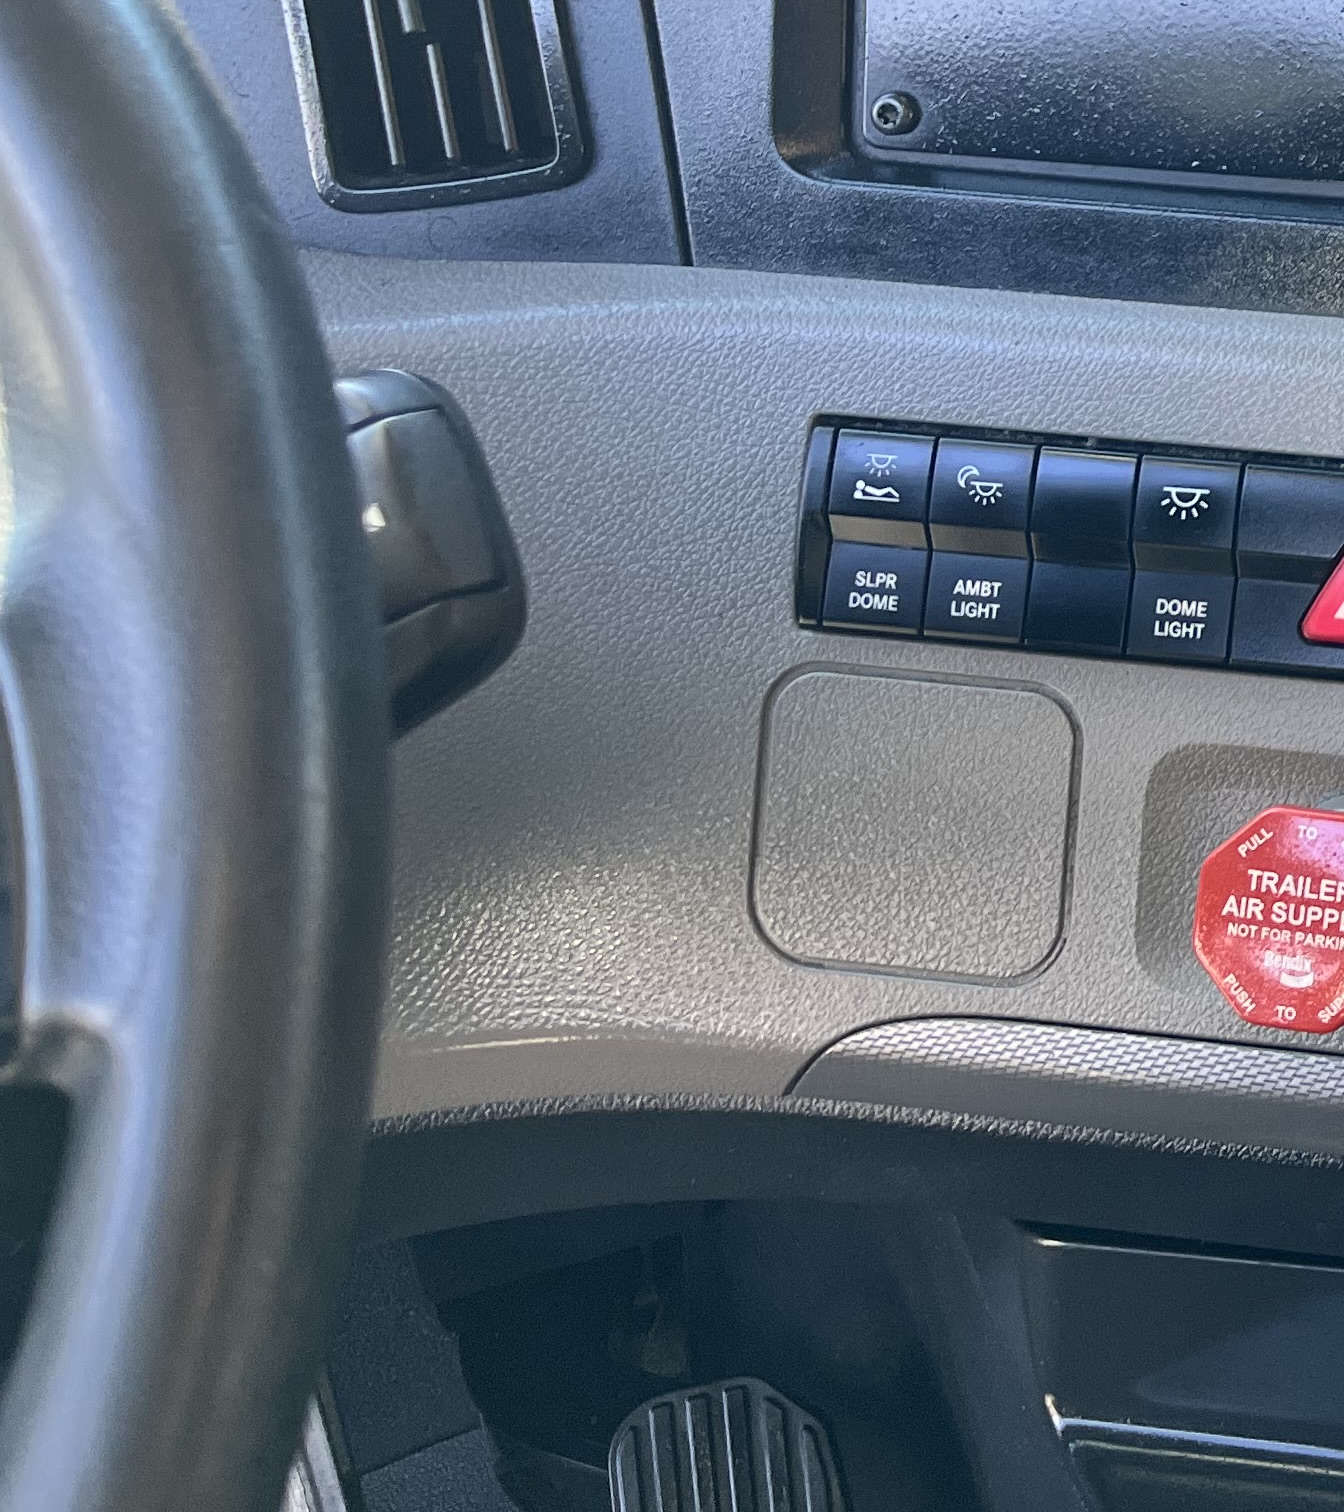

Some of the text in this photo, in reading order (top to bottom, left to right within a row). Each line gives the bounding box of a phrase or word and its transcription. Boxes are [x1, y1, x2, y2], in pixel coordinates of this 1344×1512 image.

[854, 571, 898, 590] SLPR
[952, 579, 1002, 599] AMBT
[848, 592, 898, 612] DOME
[950, 600, 1001, 620] LIGHT
[1155, 598, 1208, 619] DOME
[1153, 620, 1205, 640] LIGHT
[1236, 826, 1274, 858] PULL
[1297, 824, 1319, 839] TO
[1221, 895, 1264, 921] AIR
[1226, 922, 1259, 940] NOT
[1260, 926, 1292, 944] FOR
[1263, 949, 1313, 972] Bendix
[1223, 972, 1257, 1013] PUSH
[1276, 1005, 1297, 1021] TO
